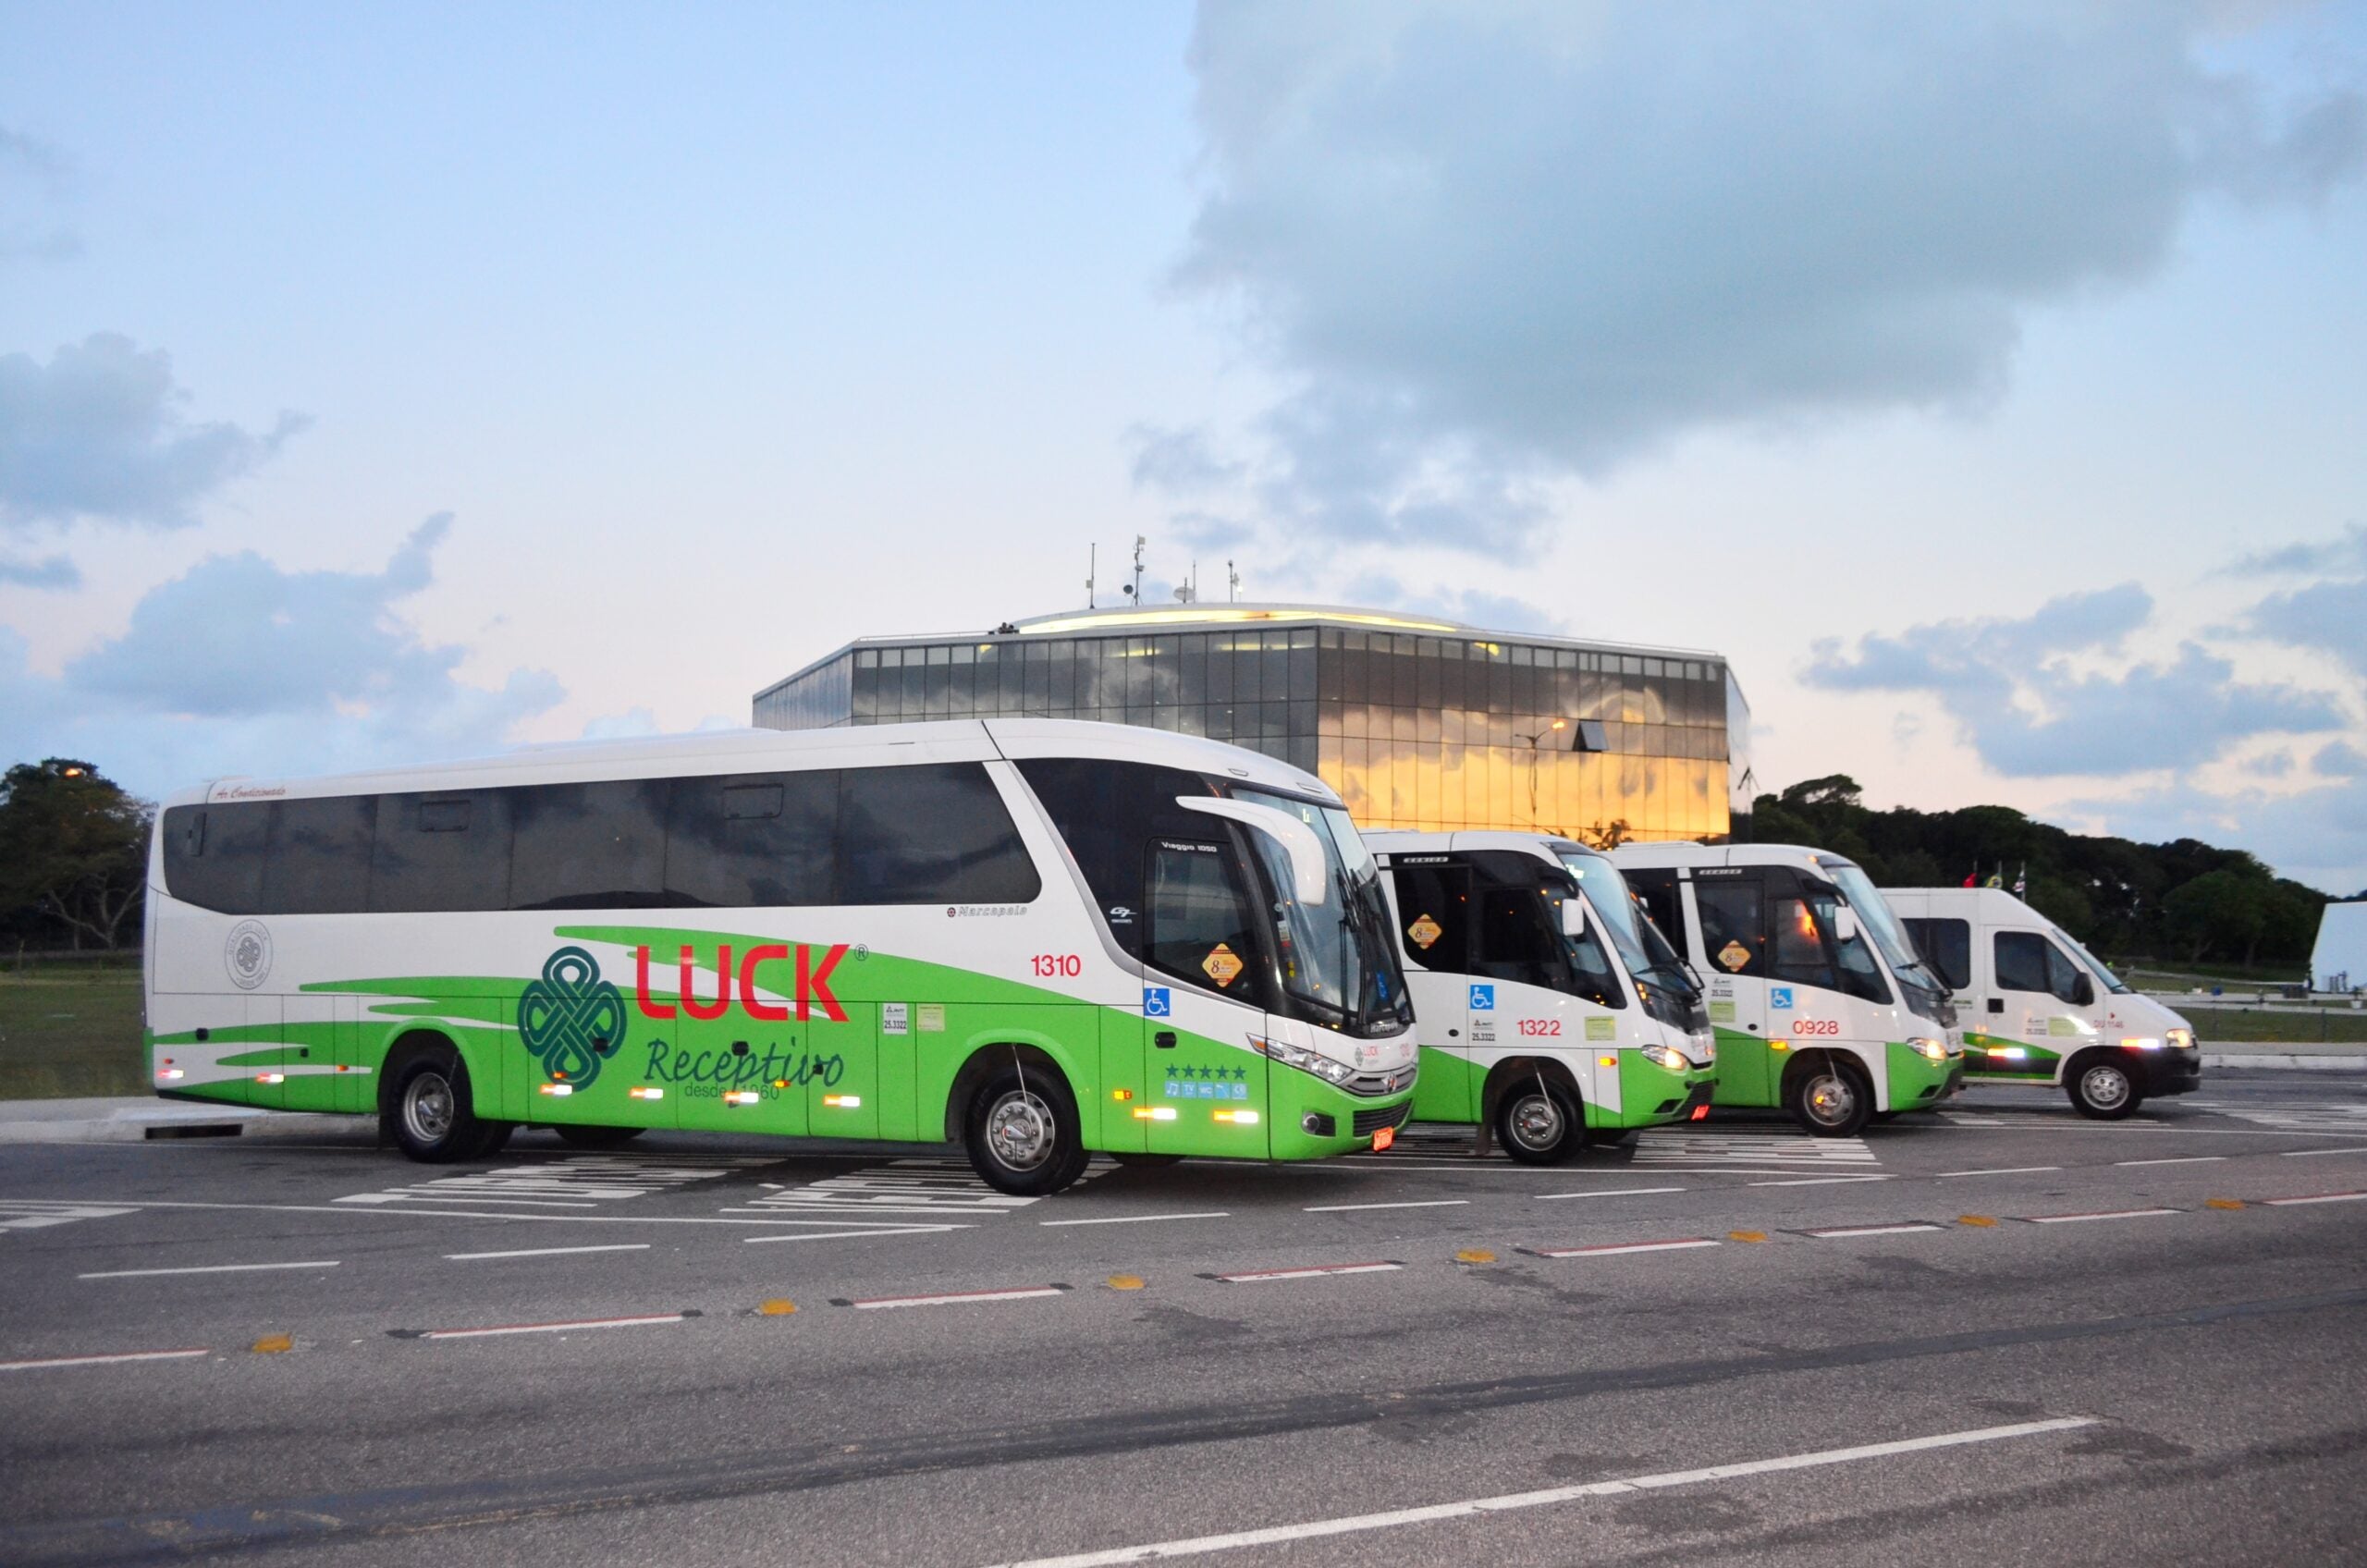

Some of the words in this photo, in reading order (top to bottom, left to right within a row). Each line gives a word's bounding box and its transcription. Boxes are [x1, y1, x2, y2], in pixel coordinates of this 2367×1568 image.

[1161, 840, 1195, 851] Viaggio
[958, 905, 1028, 917] Marcopolo
[1030, 954, 1082, 977] 1310
[636, 944, 851, 1023] LUCK
[884, 1020, 907, 1029] 25.3322
[1516, 1019, 1562, 1036] 1322
[1793, 1020, 1839, 1035] 0928
[644, 1035, 844, 1109] Receptivo
[685, 1083, 726, 1098] desde
